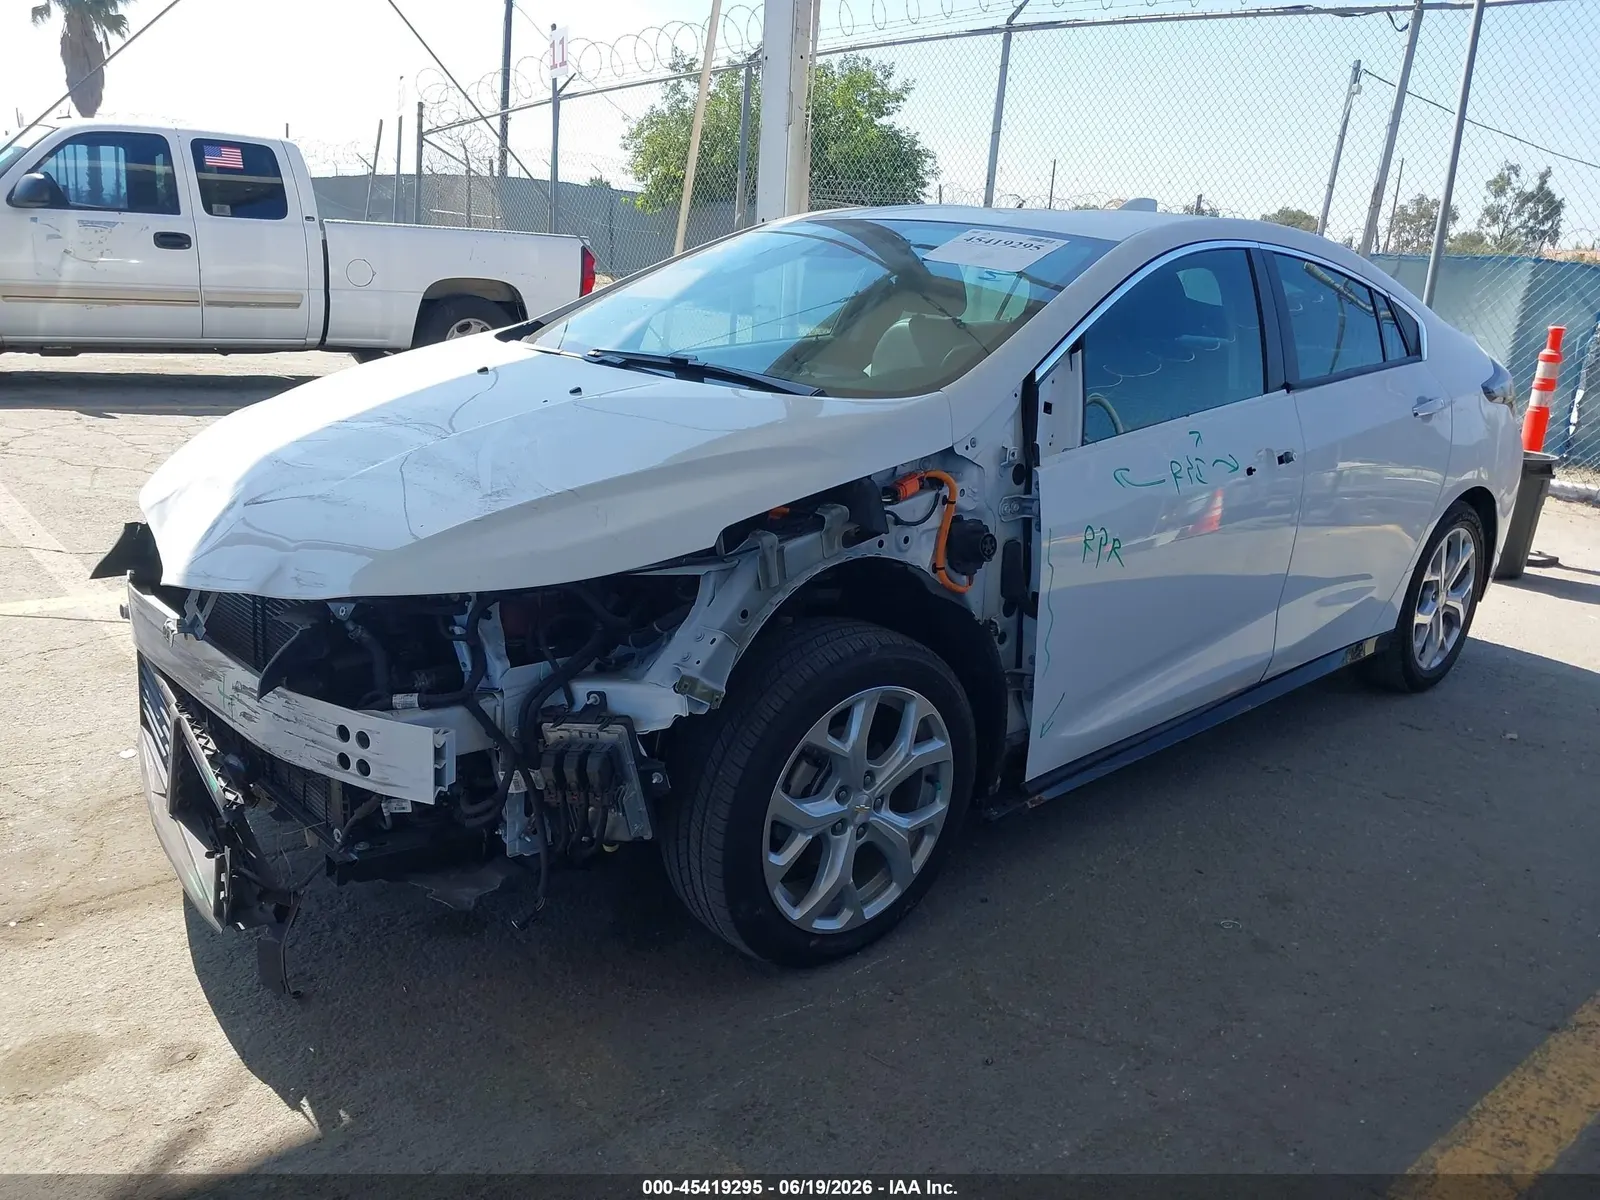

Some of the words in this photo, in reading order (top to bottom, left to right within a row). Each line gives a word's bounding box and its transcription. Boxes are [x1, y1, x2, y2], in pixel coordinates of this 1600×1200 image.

[550, 36, 567, 70] 11
[963, 235, 1044, 251] 45419295
[1082, 525, 1125, 569] RPR
